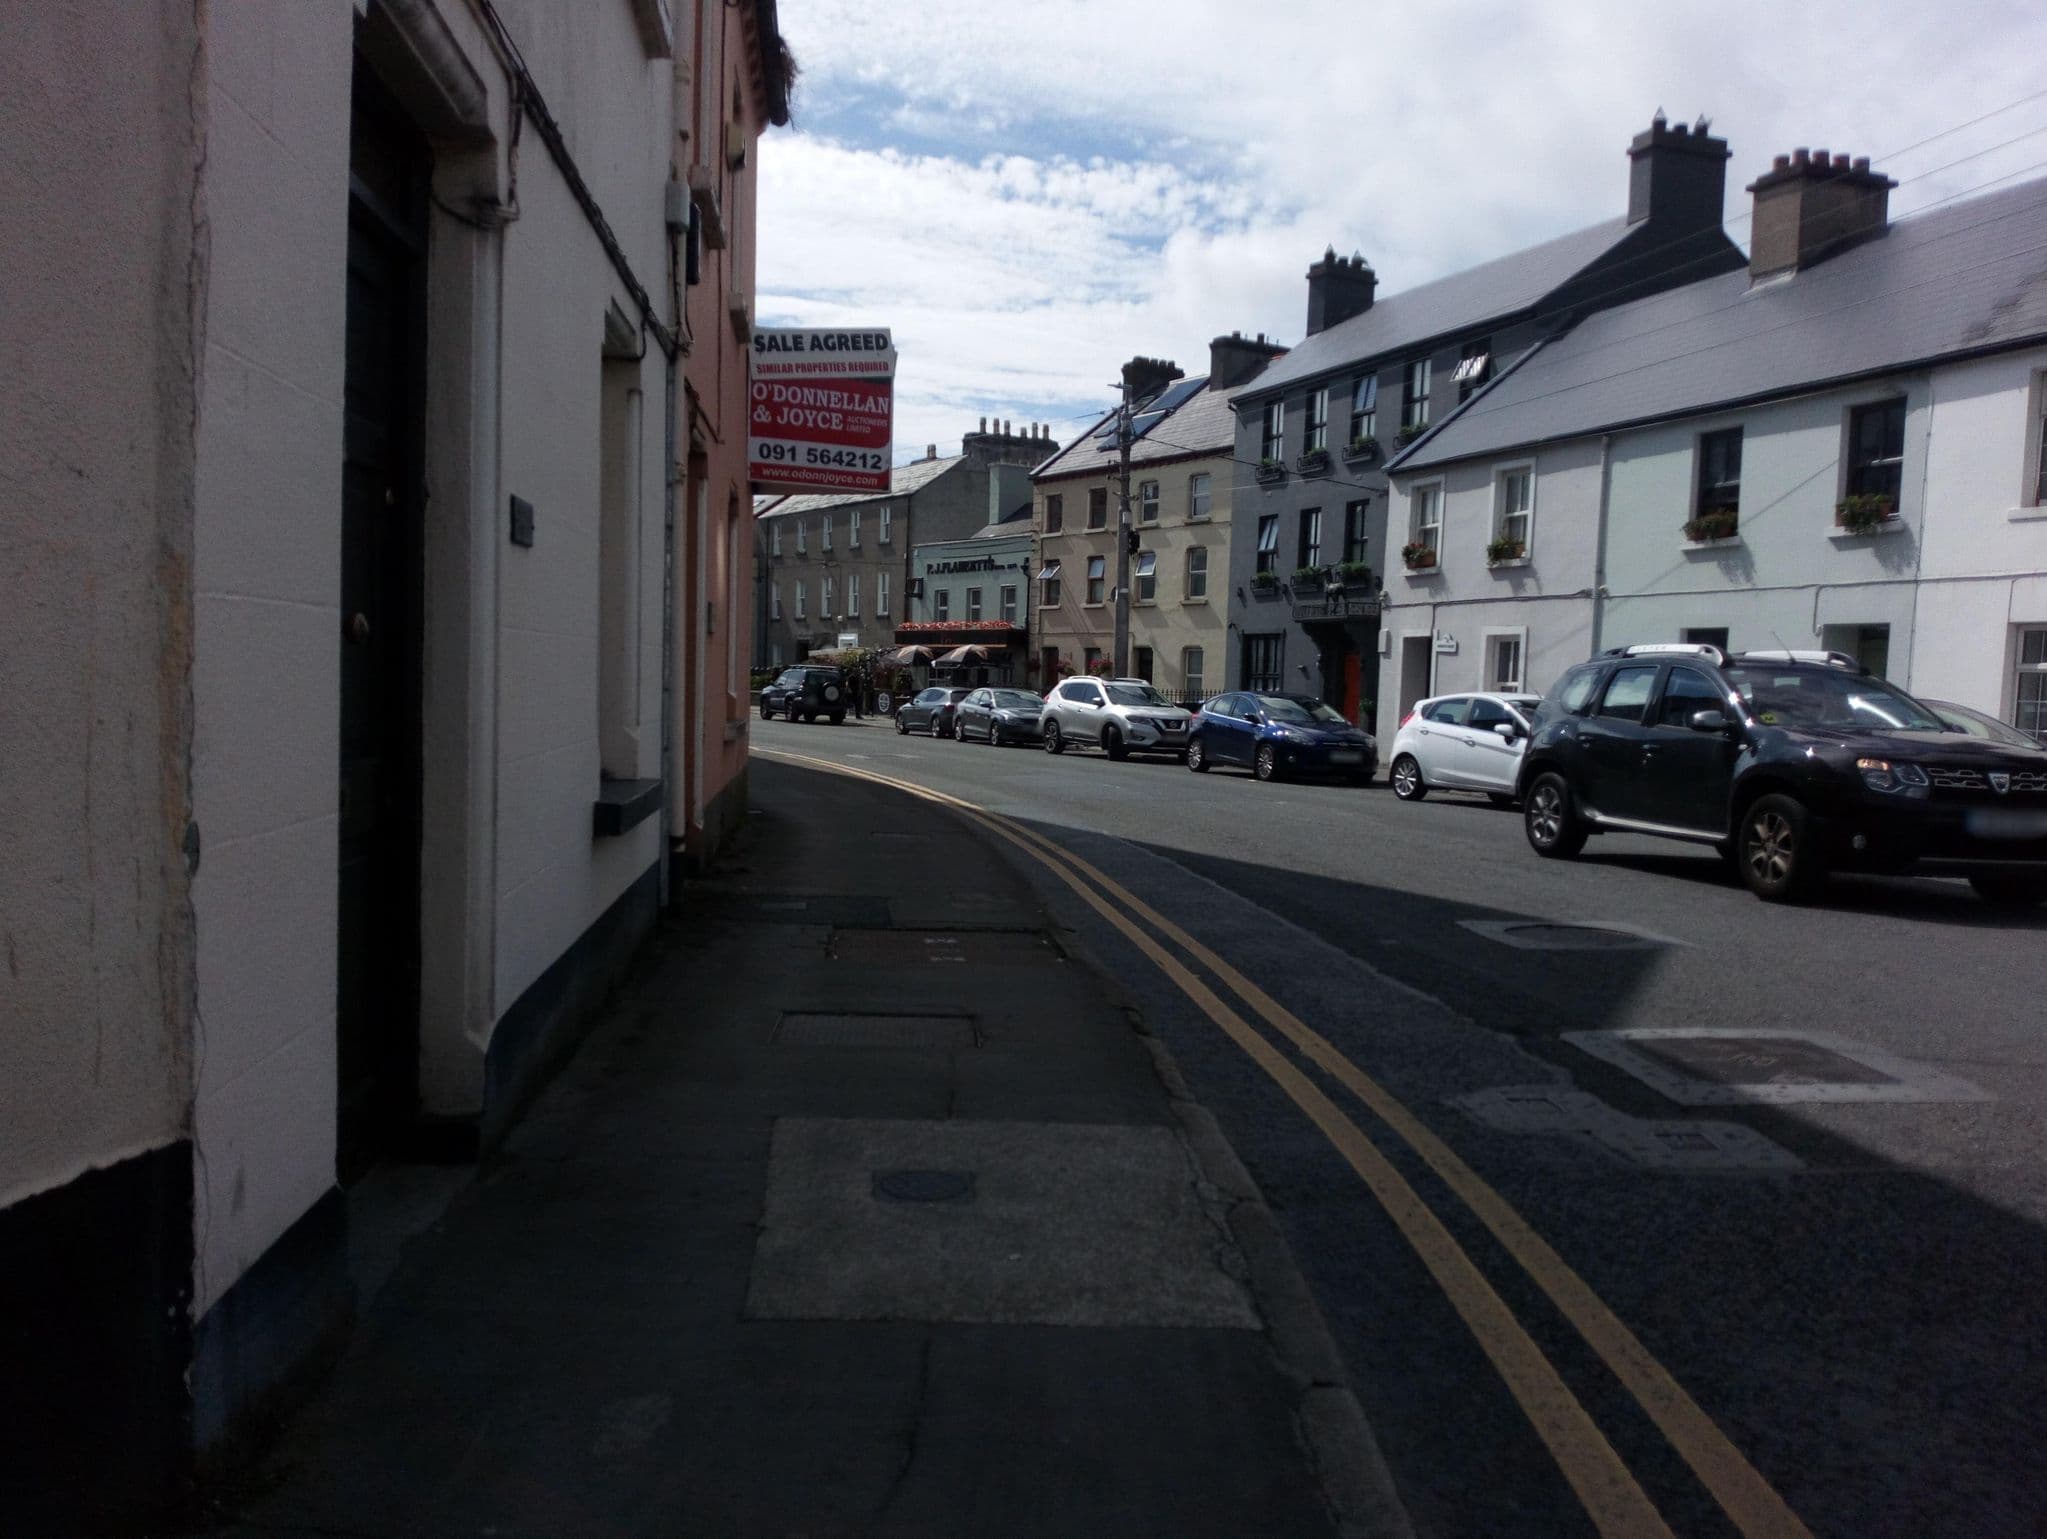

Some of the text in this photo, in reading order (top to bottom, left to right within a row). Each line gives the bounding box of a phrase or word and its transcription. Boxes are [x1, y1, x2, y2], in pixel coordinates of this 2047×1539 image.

[754, 333, 889, 353] SALE AGREED
[756, 360, 889, 374] SIMILAR PROPERTIES REQUIRED
[753, 382, 889, 415] O'DONNELLAN
[753, 404, 844, 431] & JOYCE
[759, 443, 883, 470] 091 564212
[762, 466, 879, 487] www.odonnjoyce.com
